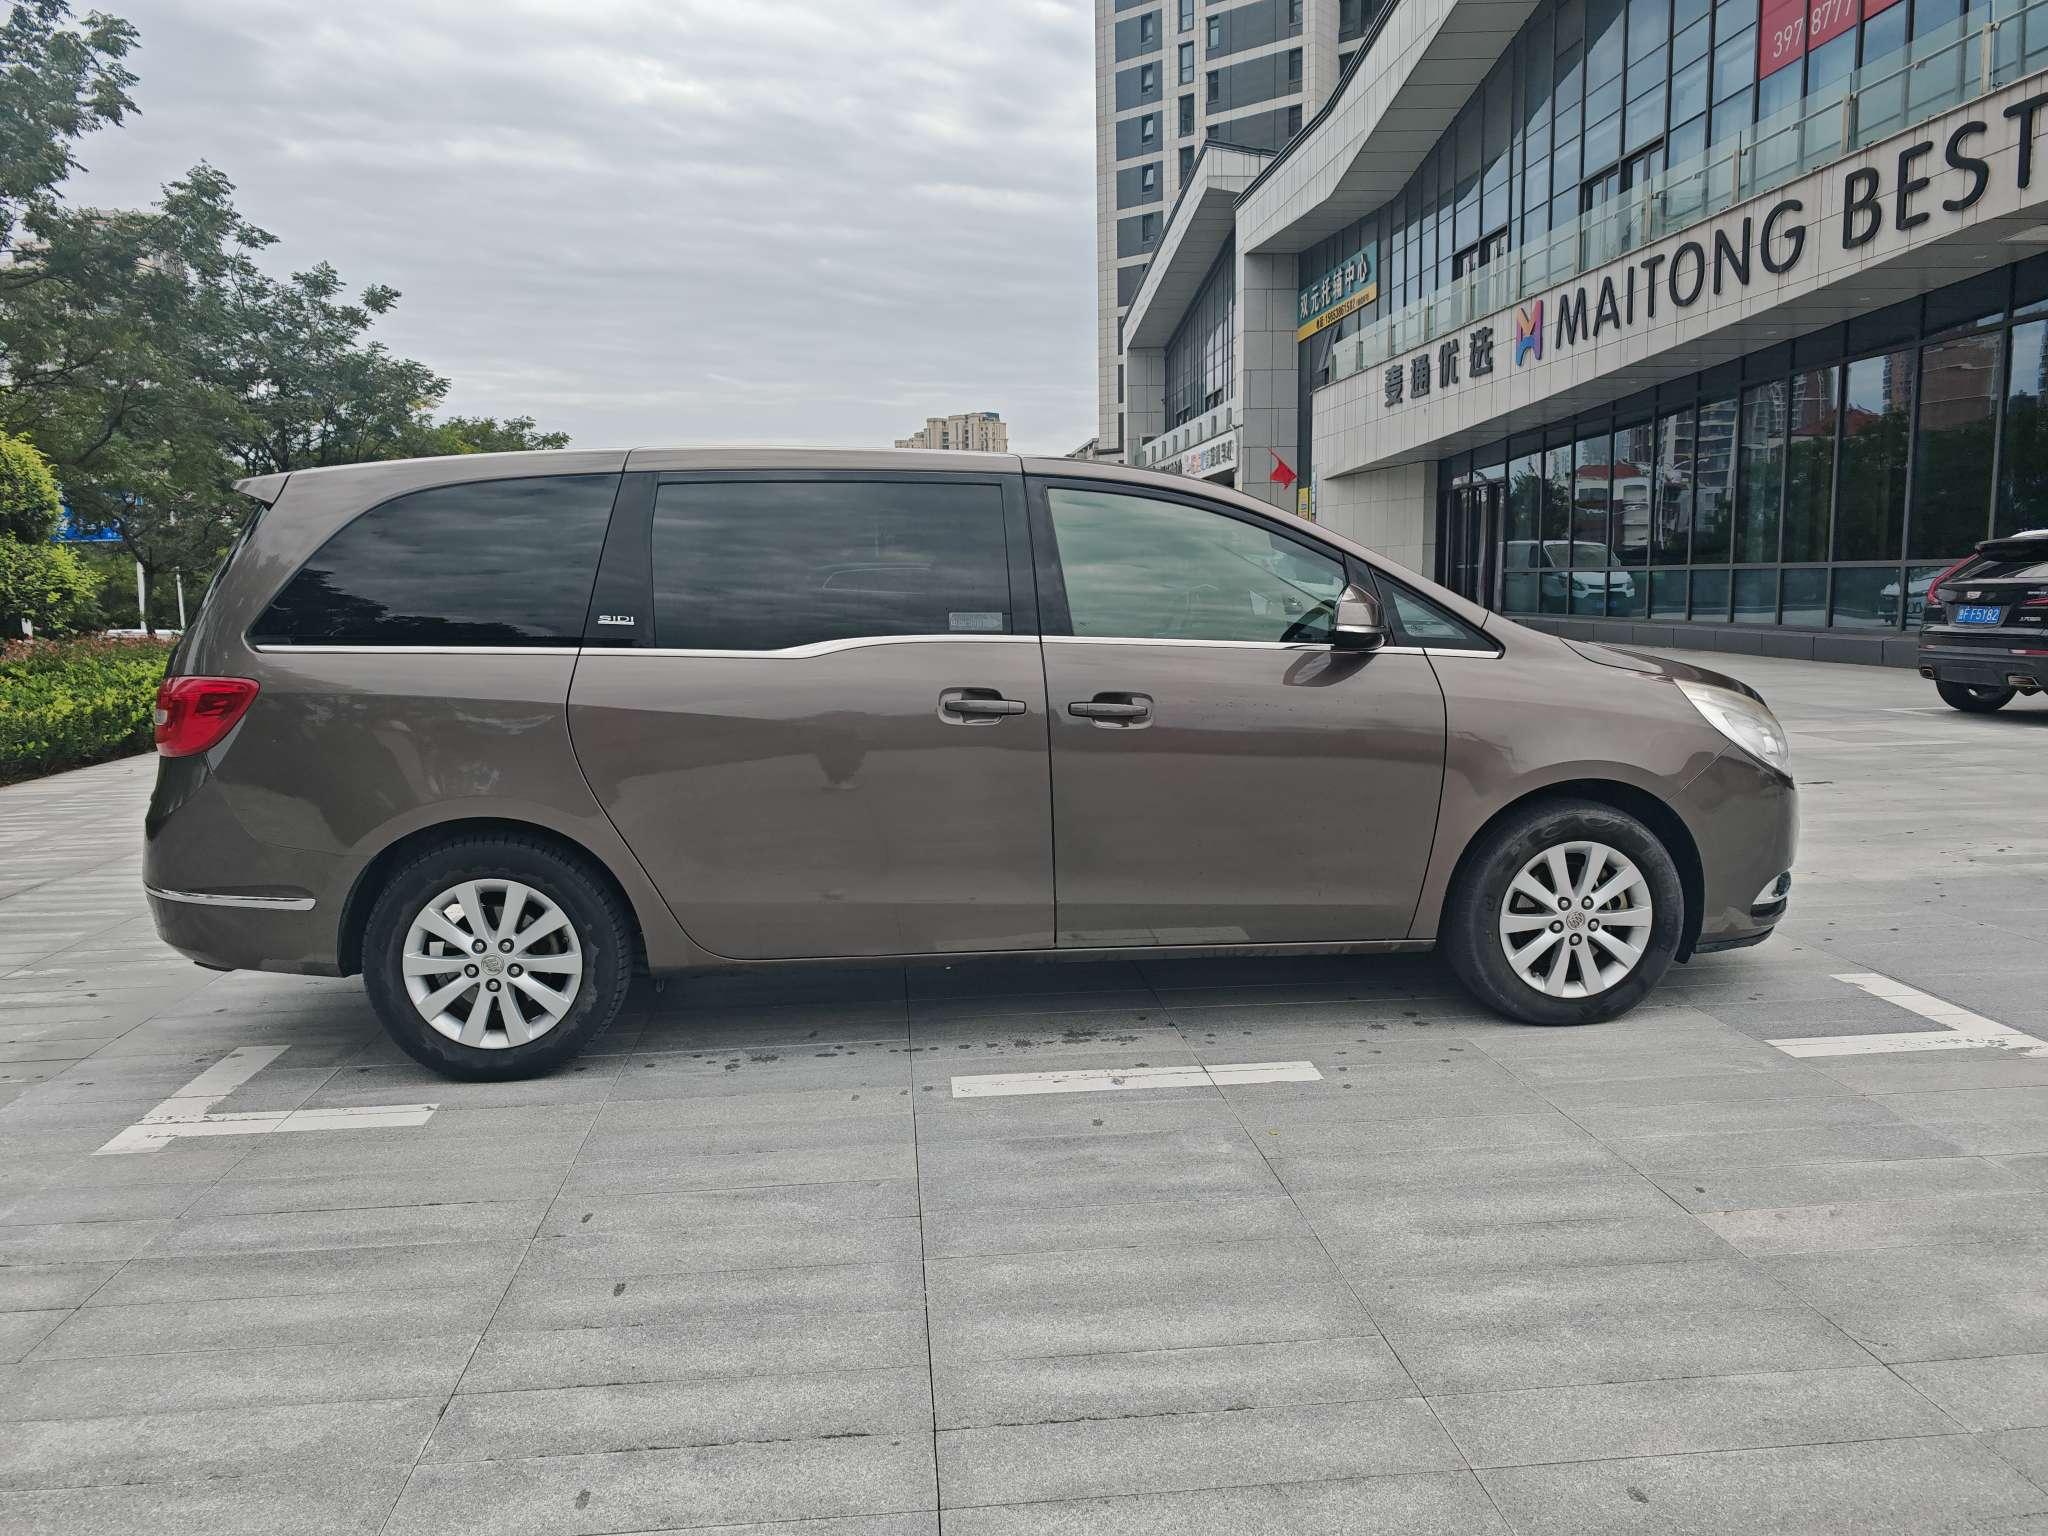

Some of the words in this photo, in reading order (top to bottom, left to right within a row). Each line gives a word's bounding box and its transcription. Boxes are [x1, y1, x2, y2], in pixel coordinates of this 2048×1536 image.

[1773, 16, 1804, 58] 397
[1555, 199, 1806, 349] MAITONG
[1843, 92, 2048, 250] BEST
[1385, 326, 1493, 407] 麦通优选
